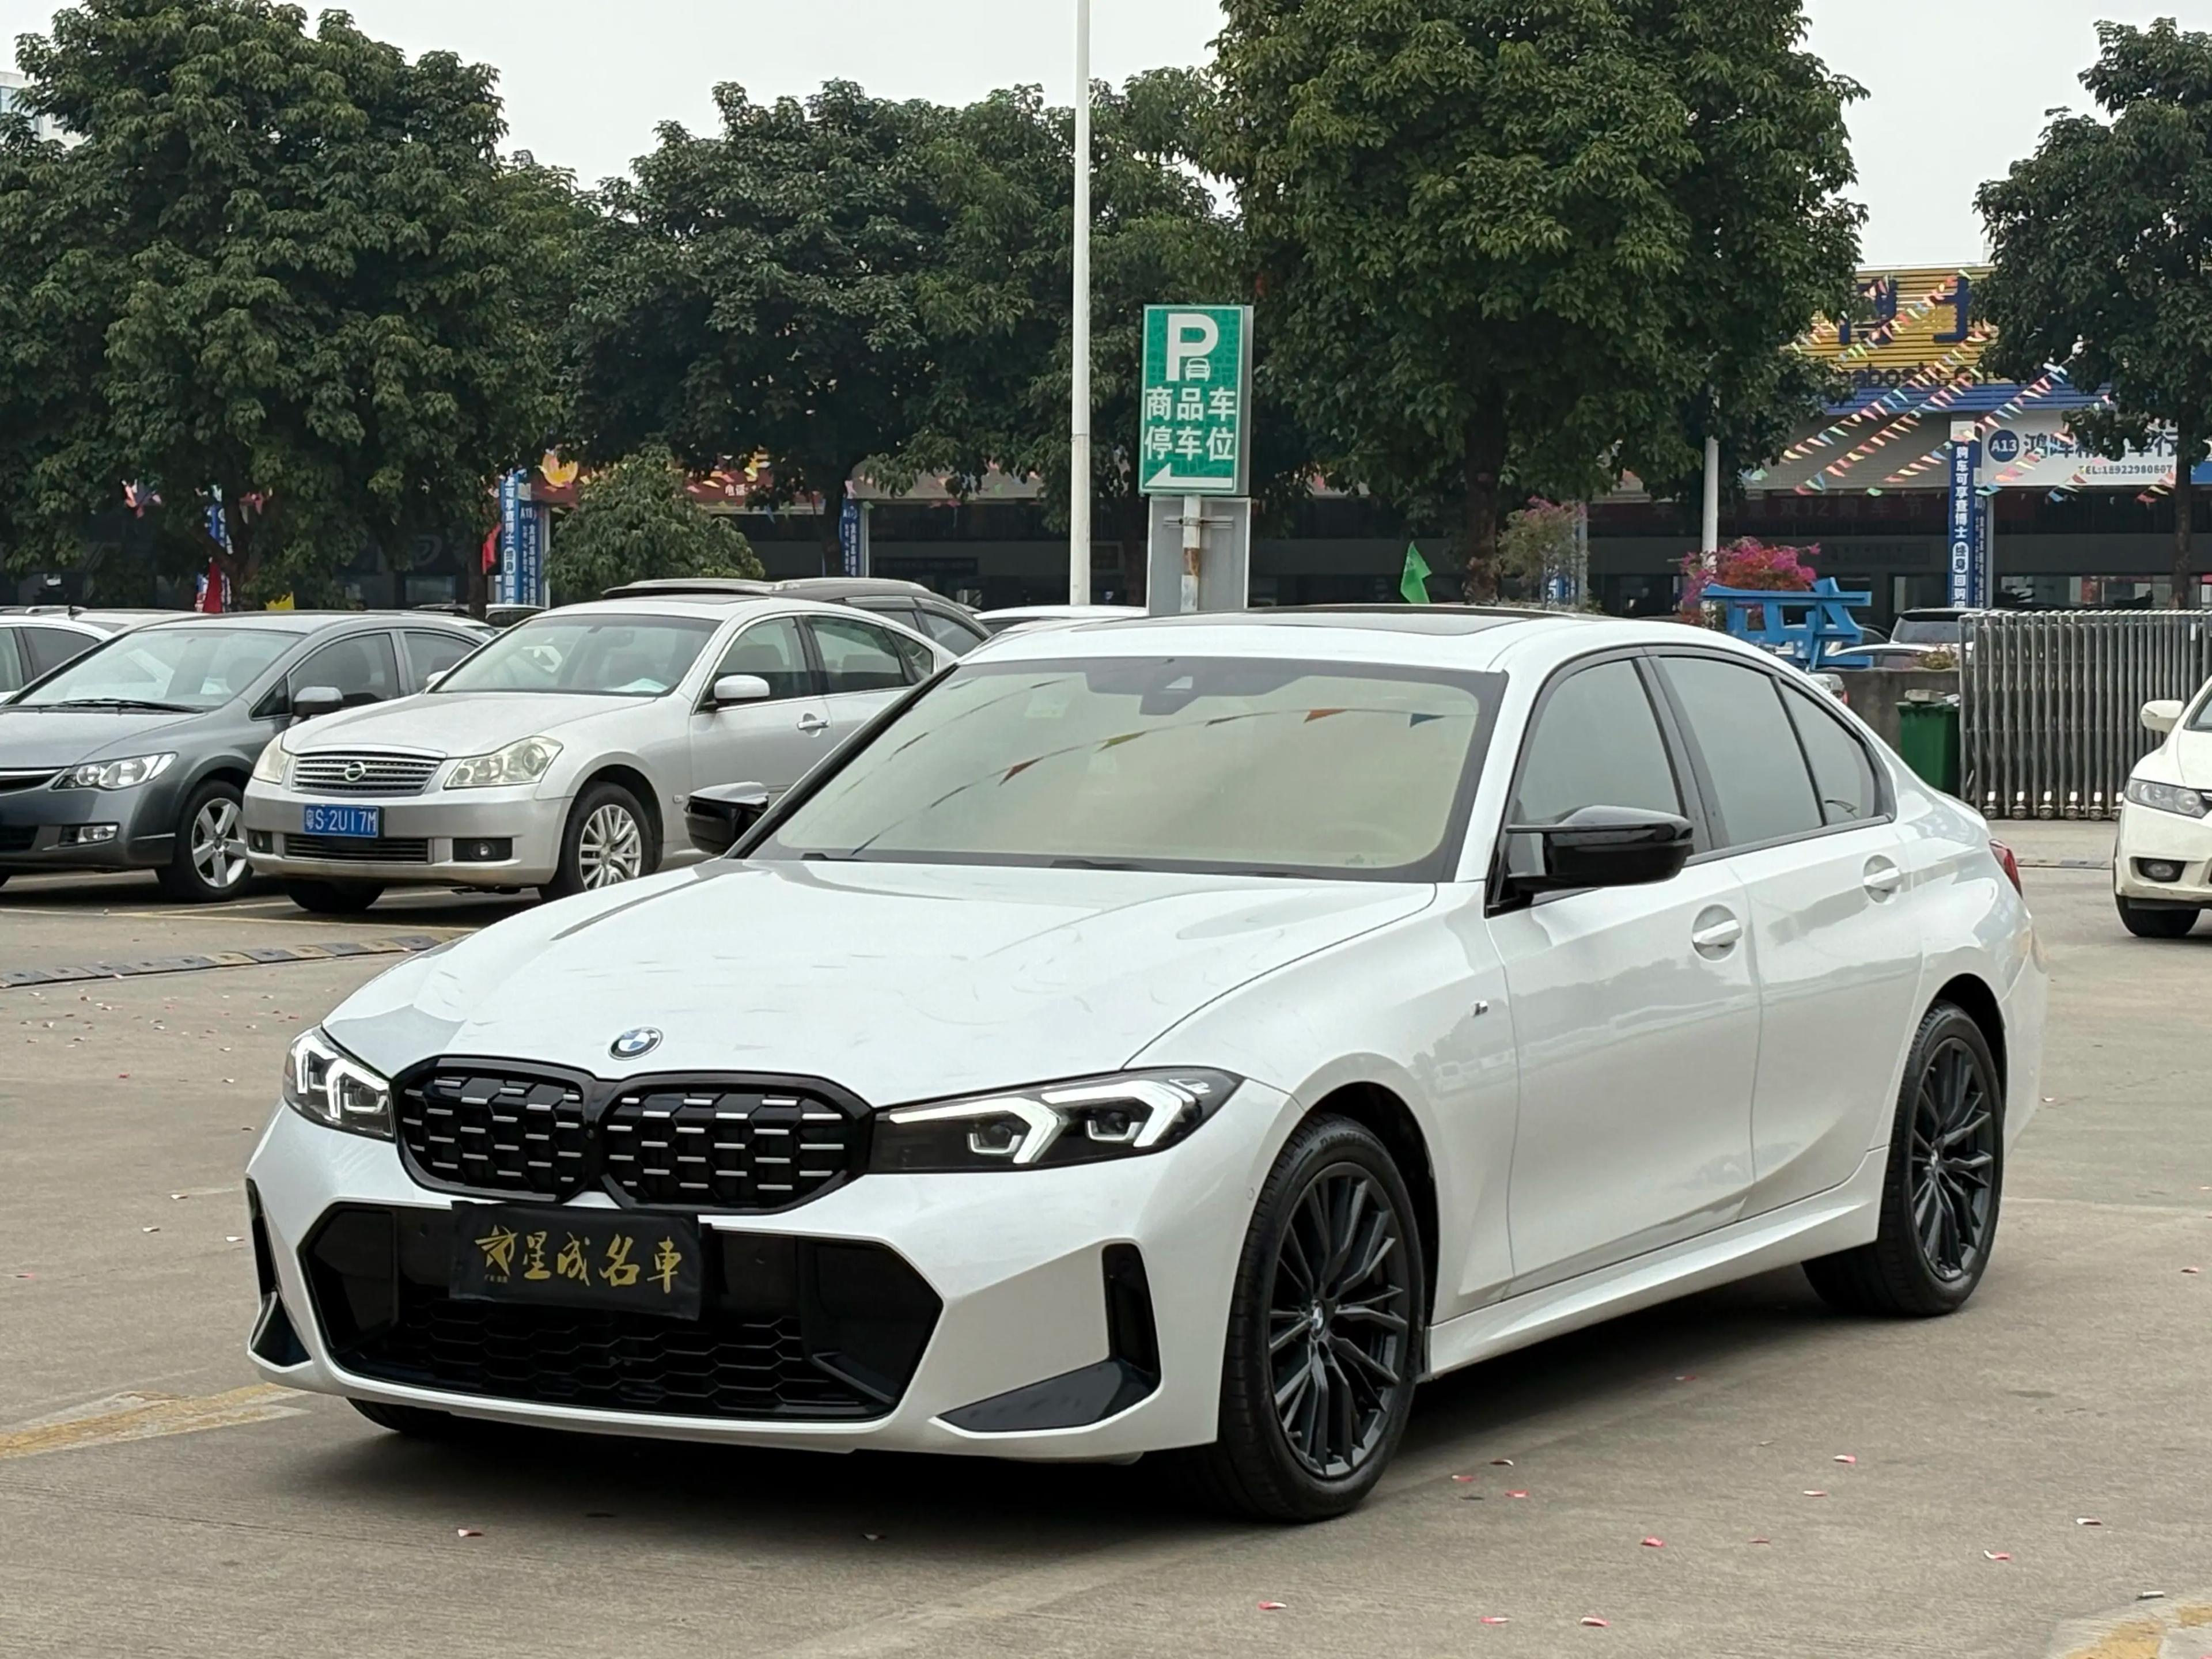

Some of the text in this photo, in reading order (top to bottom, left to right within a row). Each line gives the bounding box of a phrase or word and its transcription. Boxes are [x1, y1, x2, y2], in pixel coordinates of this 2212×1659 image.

[1166, 313, 1219, 381] P
[1145, 386, 1236, 422] 商品车
[1145, 426, 1234, 461] 停车位
[1991, 439, 2017, 452] A13
